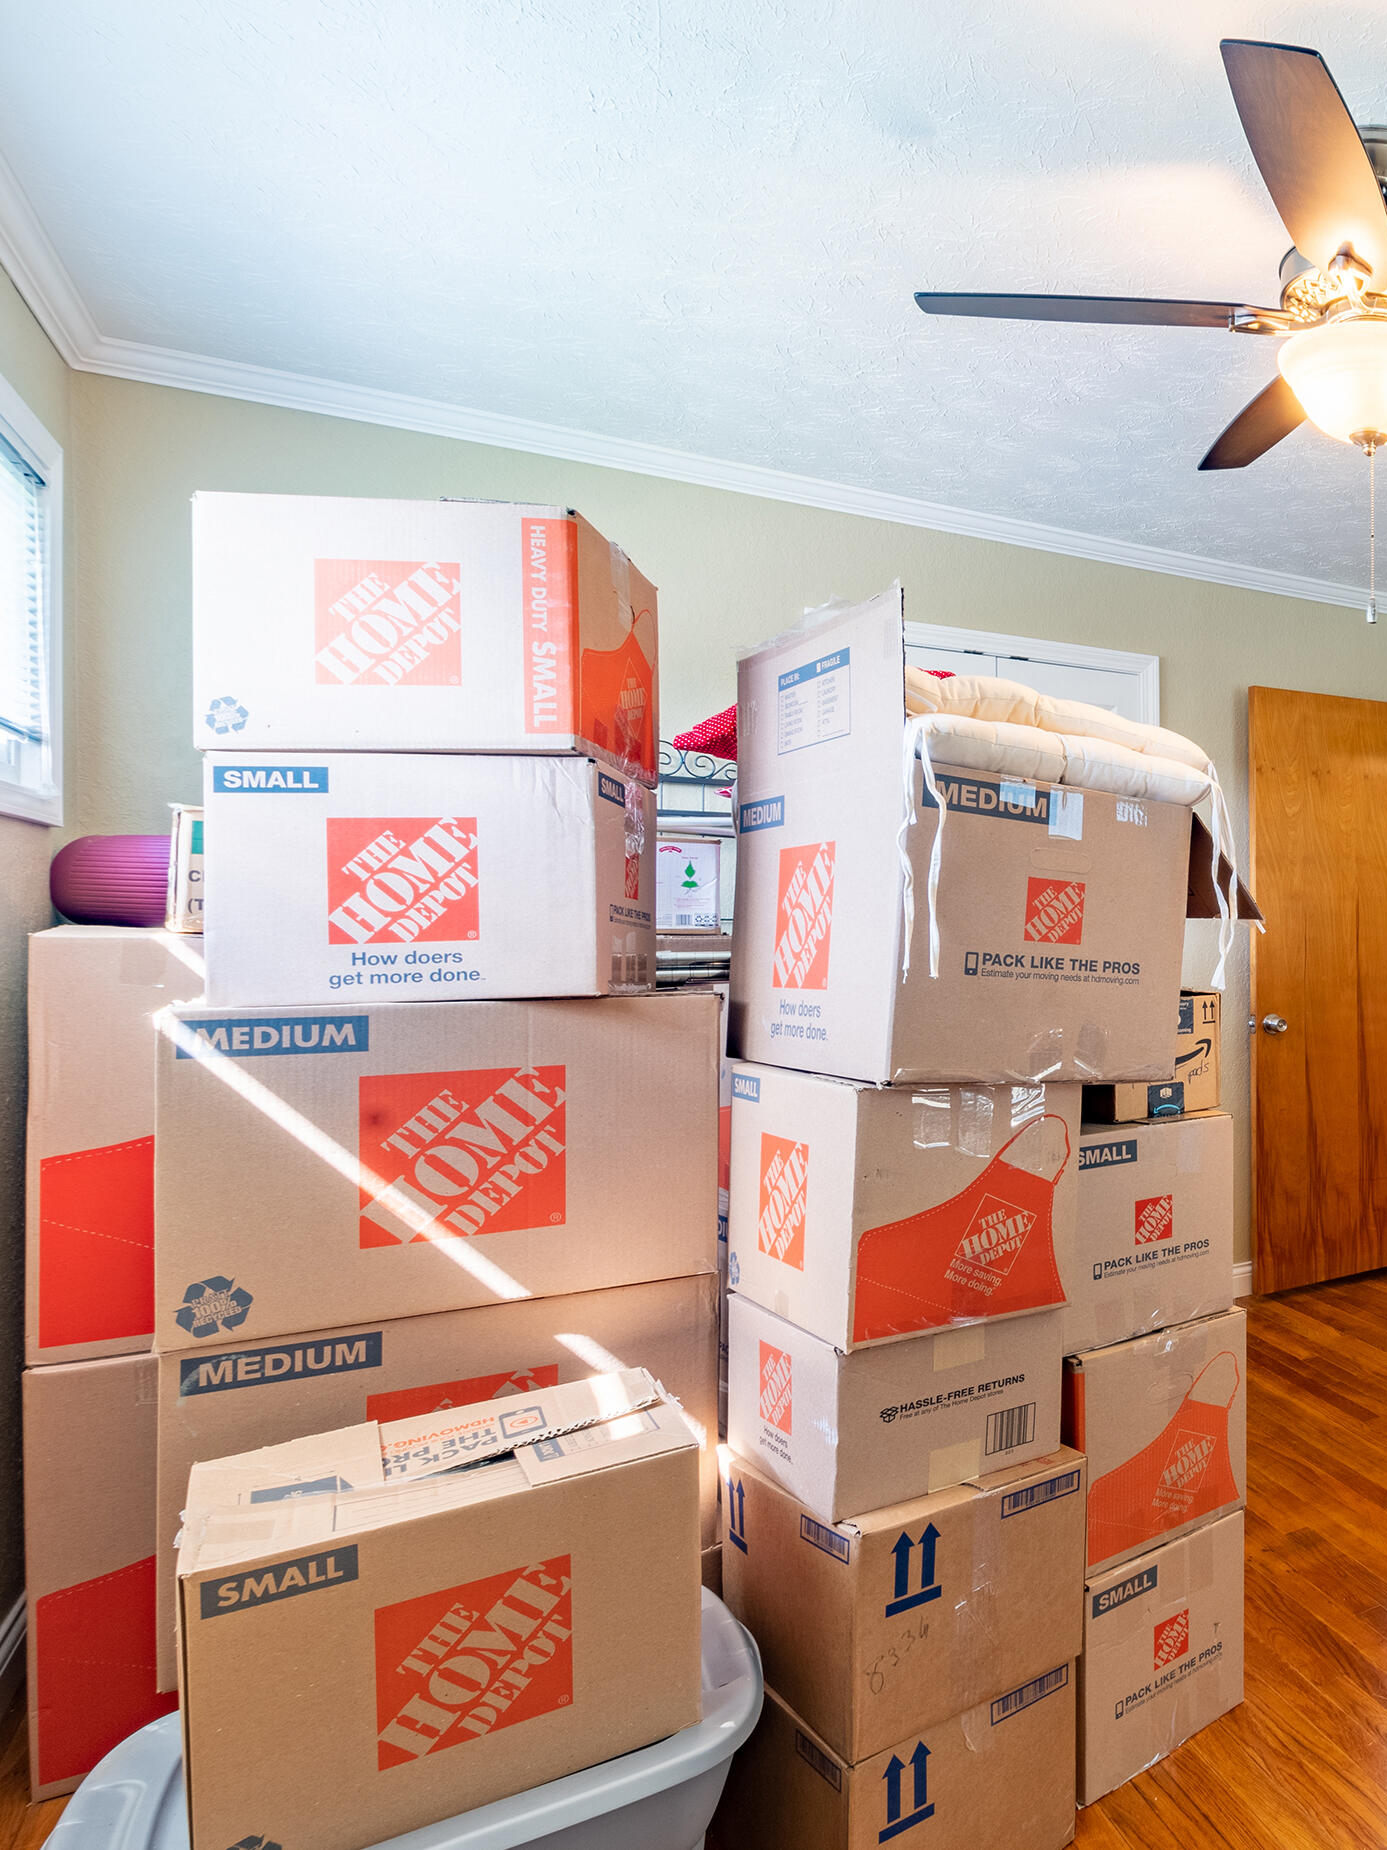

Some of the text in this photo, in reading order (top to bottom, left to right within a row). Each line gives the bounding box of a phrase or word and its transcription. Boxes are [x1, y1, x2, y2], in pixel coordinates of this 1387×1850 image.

[328, 572, 390, 622] THE
[315, 562, 461, 684] HOME
[530, 525, 557, 727] HEAVY DUTY SMALL
[372, 608, 461, 686] DEPOT
[223, 771, 318, 789] SMALL
[601, 778, 624, 802] SMALL
[744, 802, 781, 827] MEDIUM
[936, 781, 1047, 817] MEDIUM
[341, 830, 406, 881] THE
[328, 817, 479, 944] HOME
[782, 860, 806, 917] THE
[1032, 886, 1057, 910] THE
[388, 862, 479, 942] DEPOT
[774, 842, 834, 987] HOME
[1024, 882, 1086, 942] HOME
[793, 896, 832, 987] DEPOT
[1047, 906, 1083, 943] DEPOT
[351, 951, 463, 966] How doers
[981, 968, 1014, 978] Estimate
[1015, 971, 1031, 980] your
[1033, 972, 1059, 982] moving
[1060, 974, 1081, 982] needs
[982, 952, 1140, 975] PACK LIKE THE PROS
[329, 971, 363, 989] get
[370, 971, 423, 984] more
[780, 1000, 821, 1018] How doers
[196, 1024, 356, 1050] MEDIUM
[770, 1021, 783, 1039] get
[784, 1023, 804, 1037] more
[734, 1078, 758, 1097] SMALL
[380, 1089, 469, 1159] THE
[360, 1066, 567, 1243] HOME
[764, 1149, 784, 1193] THE
[1079, 1145, 1132, 1166] SMALL
[444, 1125, 566, 1235] DEPOT
[759, 1142, 808, 1254] HOME
[775, 1191, 807, 1261] DEPOT
[978, 1208, 1007, 1229] THE
[1135, 1196, 1173, 1244] HOME
[1139, 1203, 1155, 1221] THE
[1150, 1211, 1172, 1241] DEPOT
[961, 1211, 1032, 1259] HOME
[980, 1235, 1023, 1265] DEPOT
[950, 1258, 972, 1274] More
[1104, 1239, 1210, 1270] PACK LIKE THE PROS
[1104, 1269, 1125, 1278] Estimate
[1126, 1266, 1137, 1275] your
[944, 1269, 967, 1285] More
[193, 1299, 237, 1318] 100%
[198, 1340, 367, 1387] MEDIUM
[760, 1352, 792, 1420] HOME
[900, 1374, 1025, 1413] HASSLE-FREE RETURNS
[900, 1411, 913, 1420] Free
[920, 1408, 932, 1417] any
[932, 1405, 939, 1413] of
[940, 1401, 951, 1411] The
[952, 1398, 968, 1408] Home
[970, 1393, 986, 1405] Depot
[987, 1389, 1004, 1398] stores
[421, 1435, 498, 1465] PACK
[442, 1428, 496, 1449] THE
[1175, 1438, 1194, 1458] THE
[1163, 1436, 1215, 1486] HOME
[1176, 1458, 1207, 1488] DEPOT
[217, 1556, 344, 1607] SMALL
[1098, 1574, 1152, 1610] SMALL
[396, 1602, 480, 1677] THE
[1154, 1611, 1189, 1666] HOME
[1158, 1624, 1173, 1645] THE
[377, 1563, 572, 1757] HOME
[457, 1614, 572, 1736] DEPOT
[1125, 1642, 1223, 1706] PACK LIKE THE PROS
